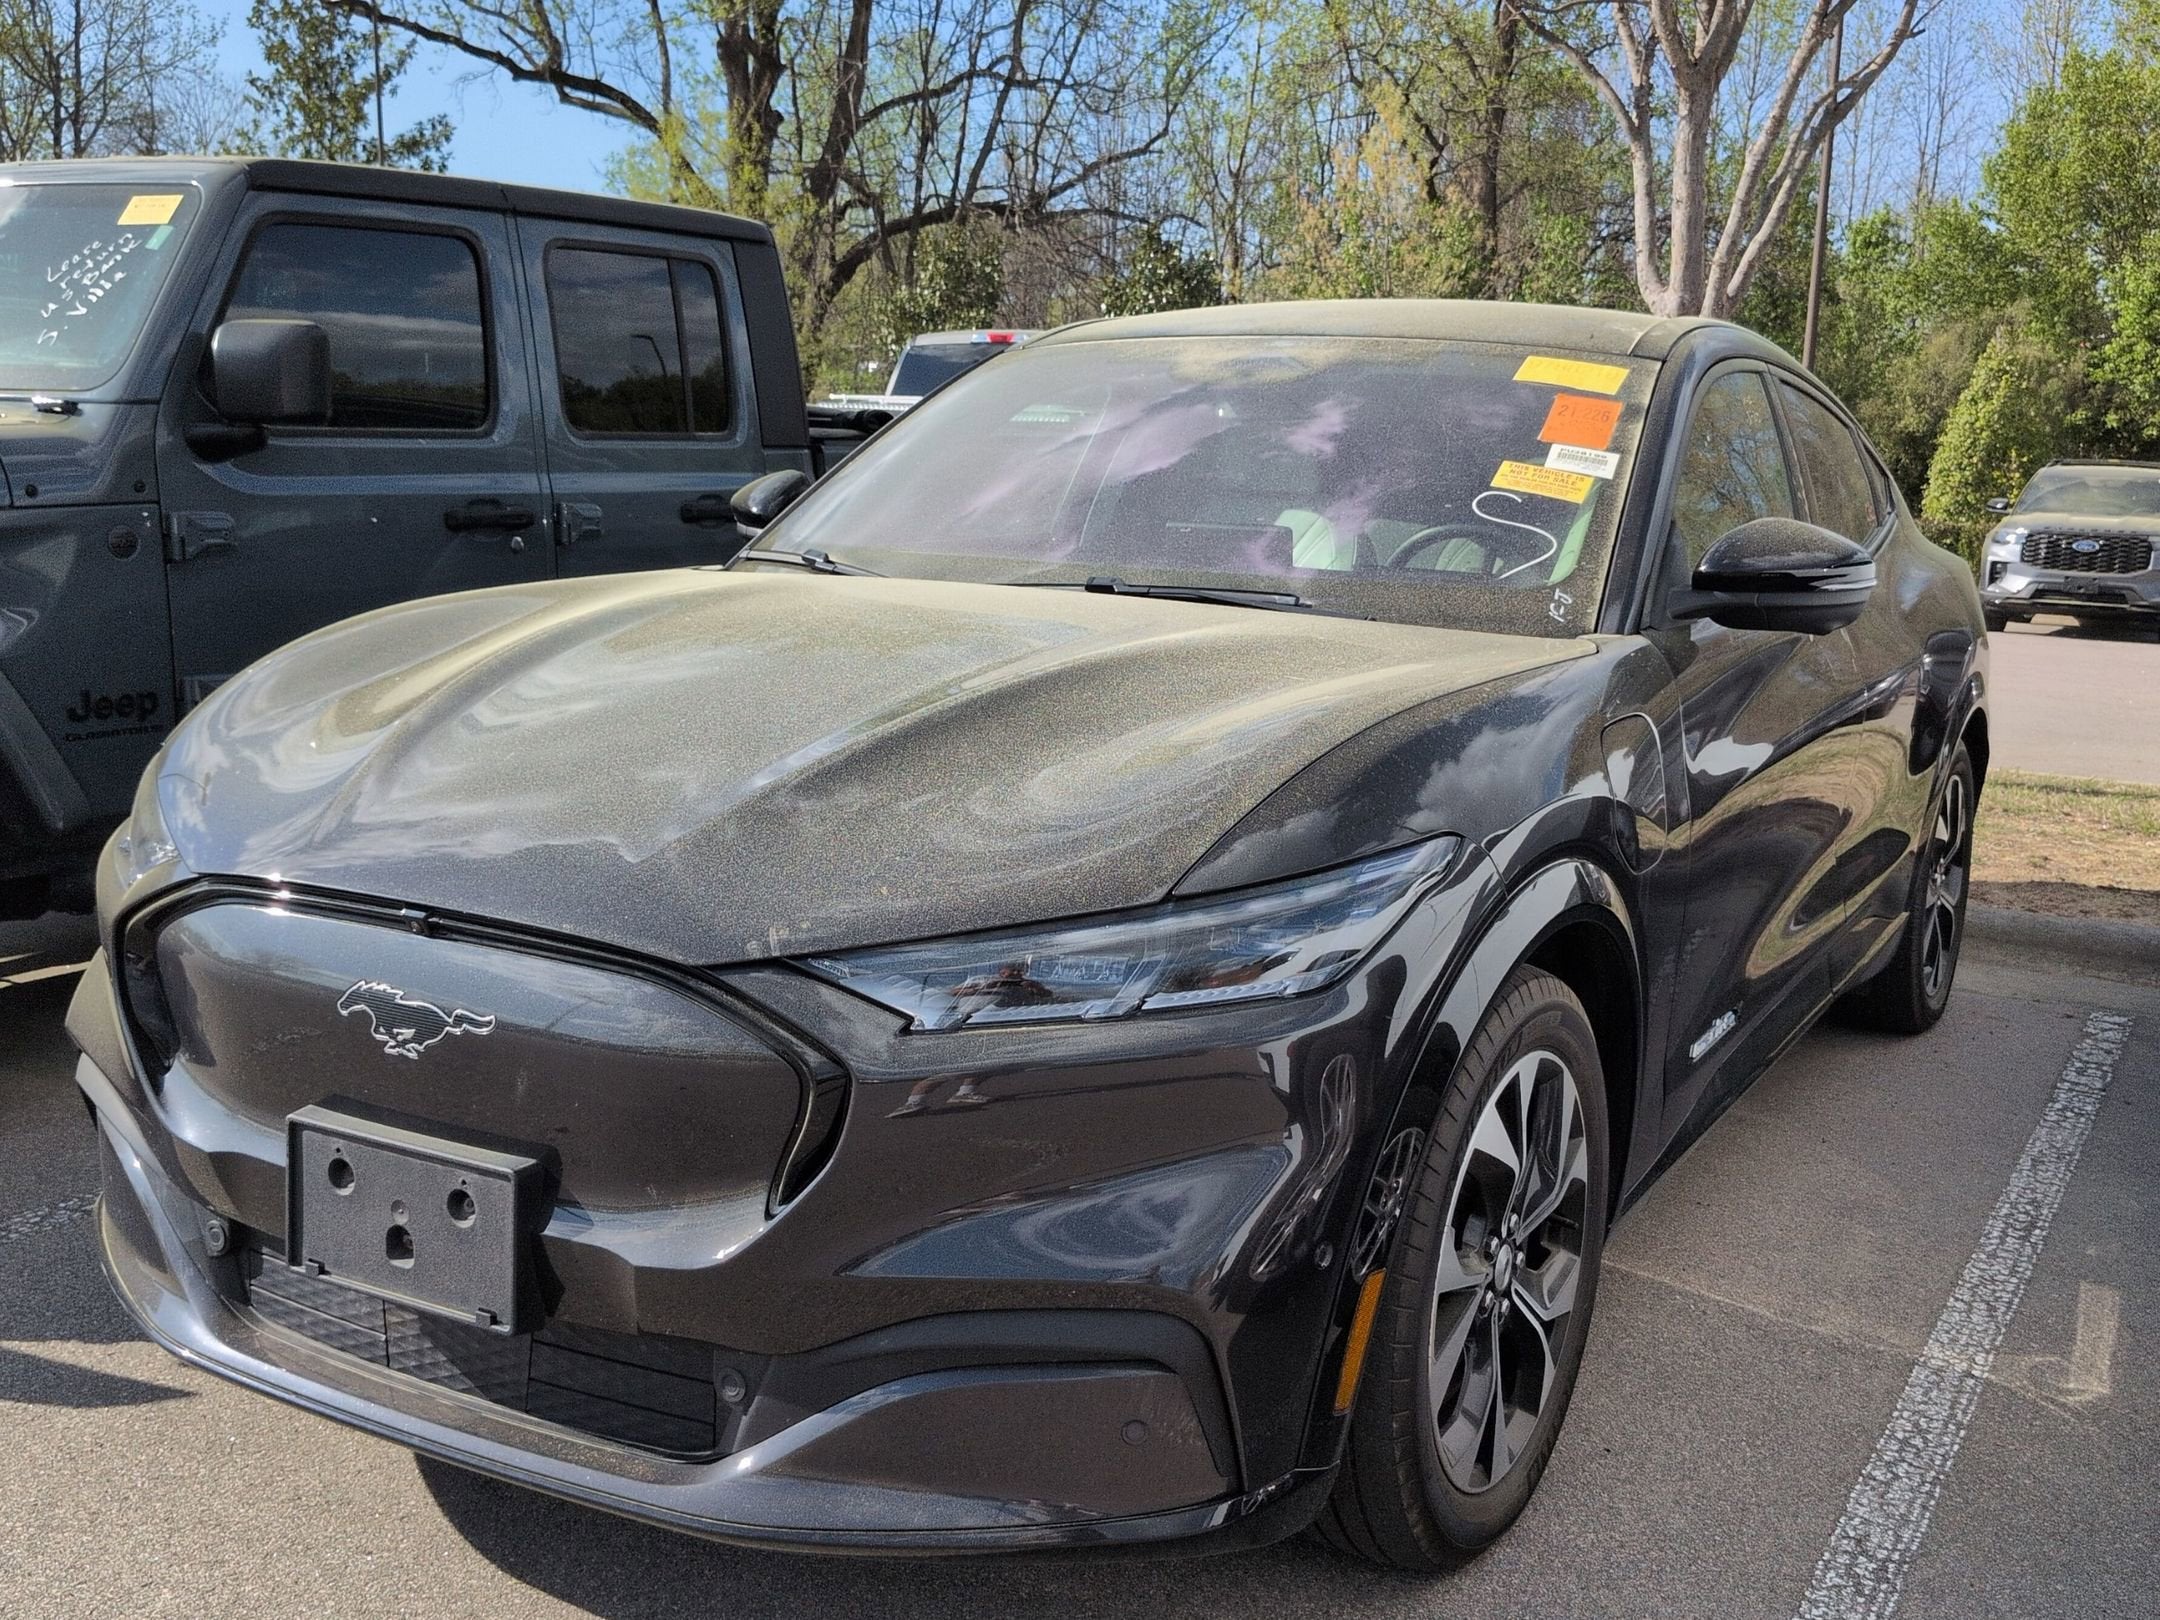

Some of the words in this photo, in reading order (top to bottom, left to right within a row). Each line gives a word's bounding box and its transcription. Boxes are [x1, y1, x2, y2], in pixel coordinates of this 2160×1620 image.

[1509, 463, 1530, 471] THIS
[1533, 466, 1571, 479] VEHICLE
[1509, 469, 1528, 477] NOT
[1531, 472, 1550, 480] FOR
[1552, 477, 1577, 486] SALE
[65, 689, 159, 722] Jeep
